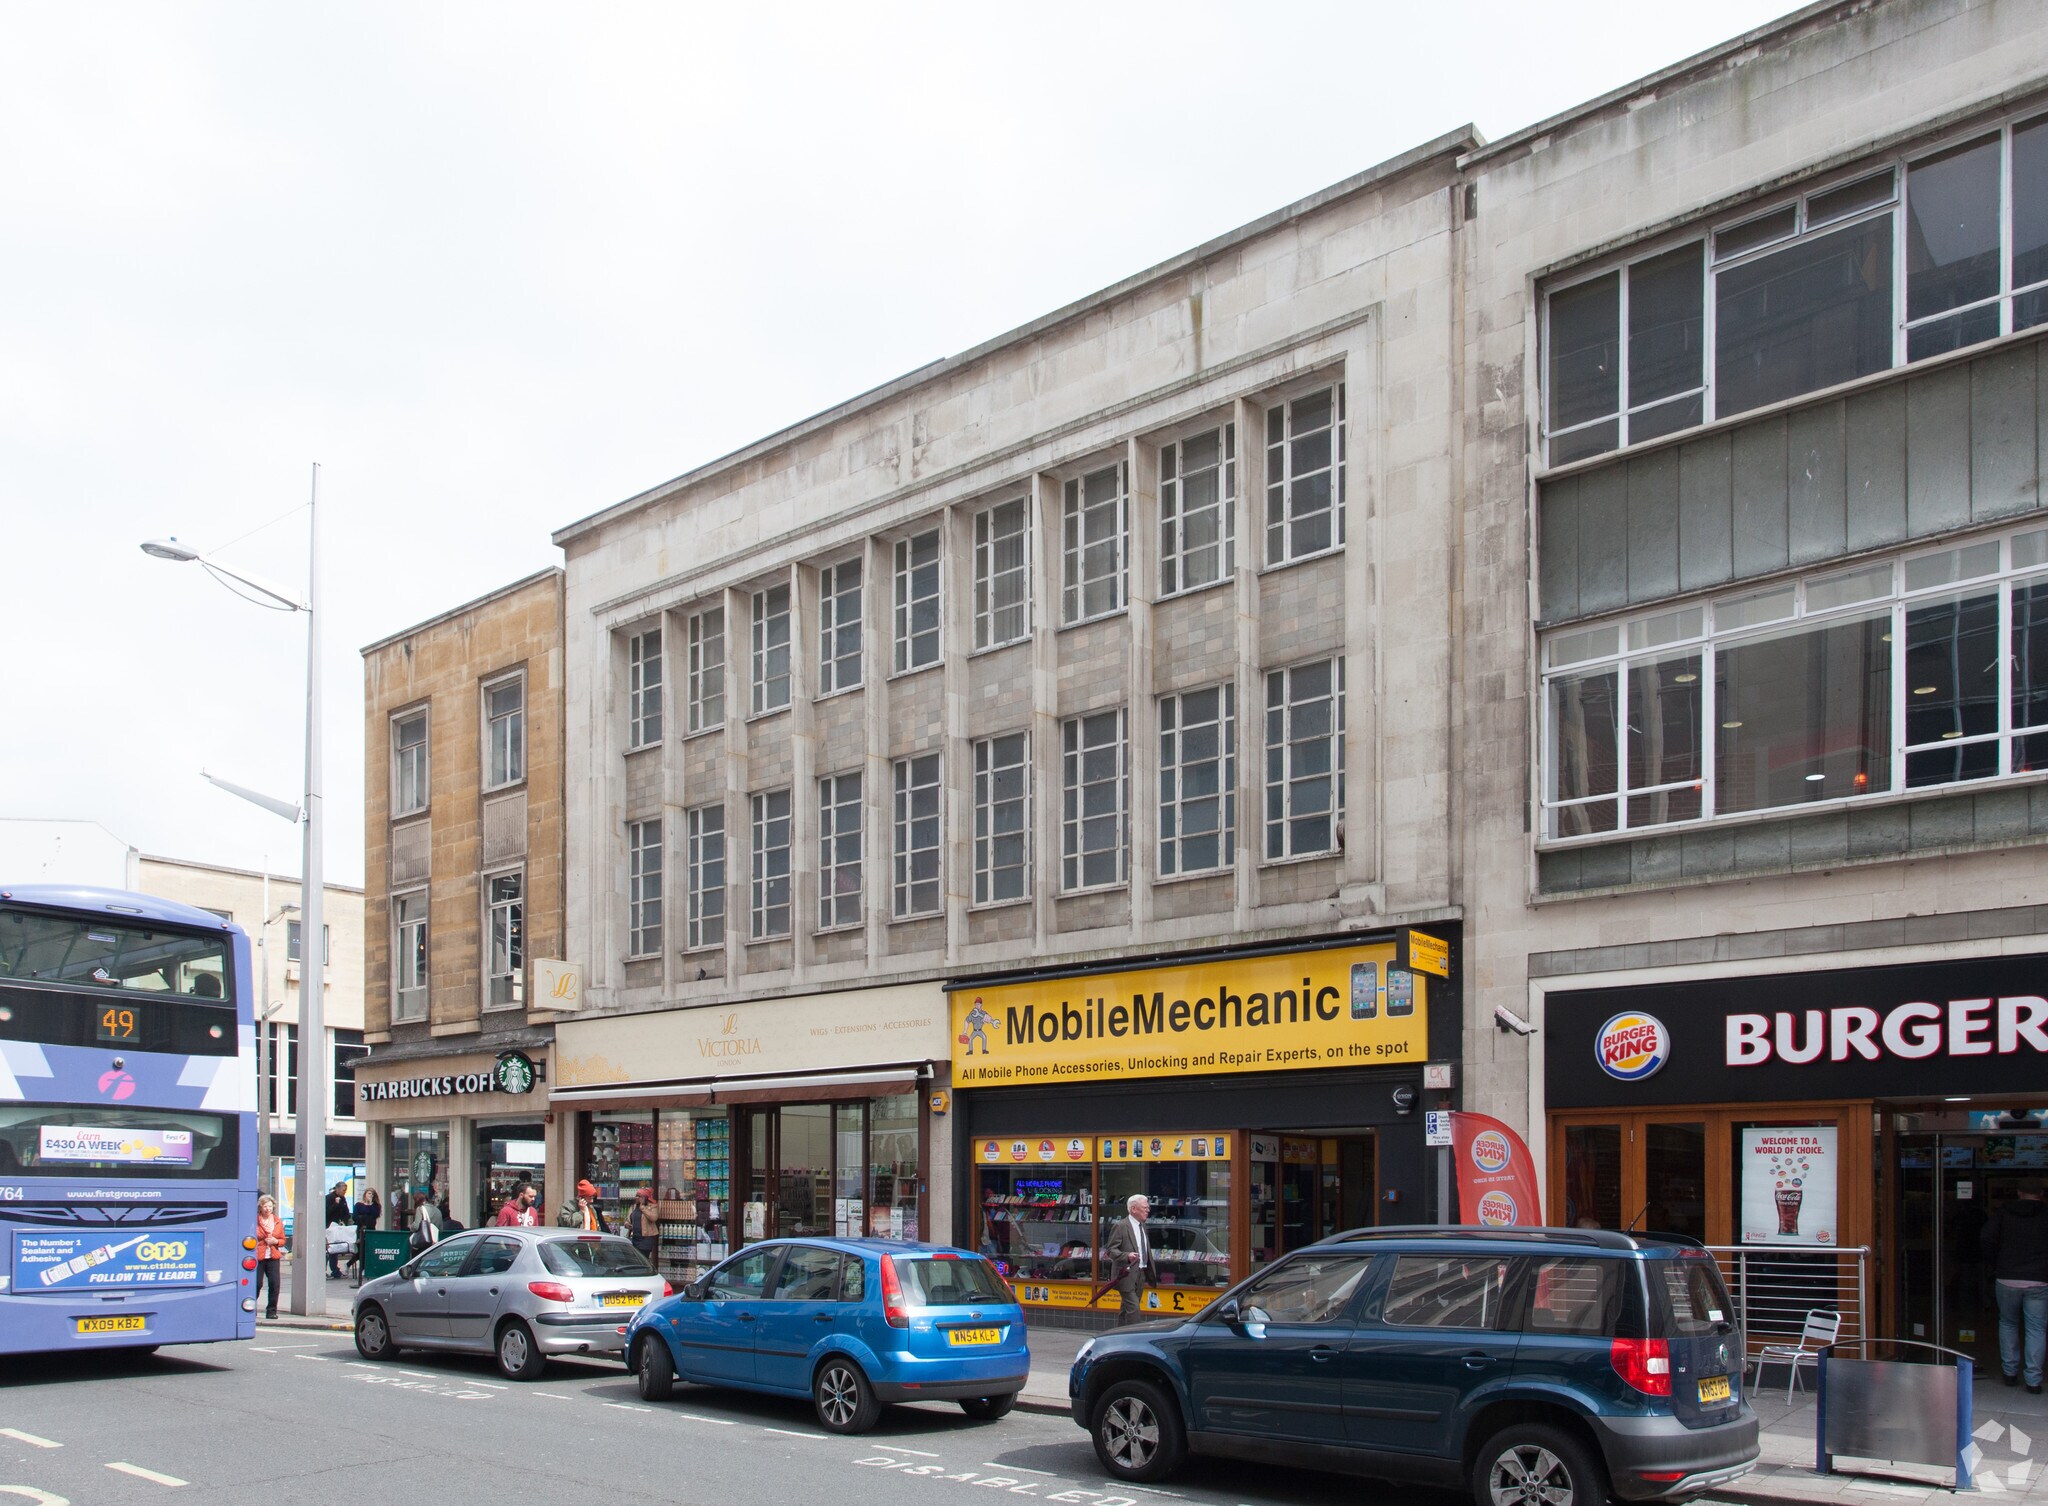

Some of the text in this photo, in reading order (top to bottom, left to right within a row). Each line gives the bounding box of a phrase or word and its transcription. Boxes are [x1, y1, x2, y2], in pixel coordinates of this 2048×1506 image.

[1411, 935, 1448, 954] MobileMechanic
[1006, 977, 1340, 1045] MobileMechanic
[102, 1008, 134, 1037] 49
[809, 1018, 932, 1036] WIGS EXTENSIONS ACCESSORIES
[1603, 1025, 1656, 1049] BURGER
[1726, 996, 2048, 1066] BURGER
[697, 1037, 762, 1058] VICTORIA
[1605, 1036, 1657, 1065] KING
[717, 1059, 742, 1067] LONDON
[962, 1040, 1409, 1080] All Mobile Phone Accessories, Unlocking and Repair Experts, on the spot
[360, 1073, 496, 1101] STARBUCKS COFF
[77, 1131, 100, 1141] Earn
[1761, 1137, 1818, 1145] WELCOME TO A
[46, 1139, 76, 1149] £430
[77, 1141, 87, 1149] A
[1755, 1146, 1825, 1154] WORLD OF CHOICE.
[67, 1189, 161, 1199] www.firstgroup.com
[21, 1239, 38, 1247] The
[39, 1239, 74, 1247] Number
[21, 1247, 56, 1255] Sealant
[21, 1255, 62, 1263] Adhesive
[89, 1271, 197, 1283] FOLLOW THE LEADER
[604, 1295, 626, 1304] DU52
[83, 1318, 140, 1331] WX09 KBZ
[954, 1330, 995, 1342] WN54 KLP
[852, 1457, 1138, 1506] DISABLED
